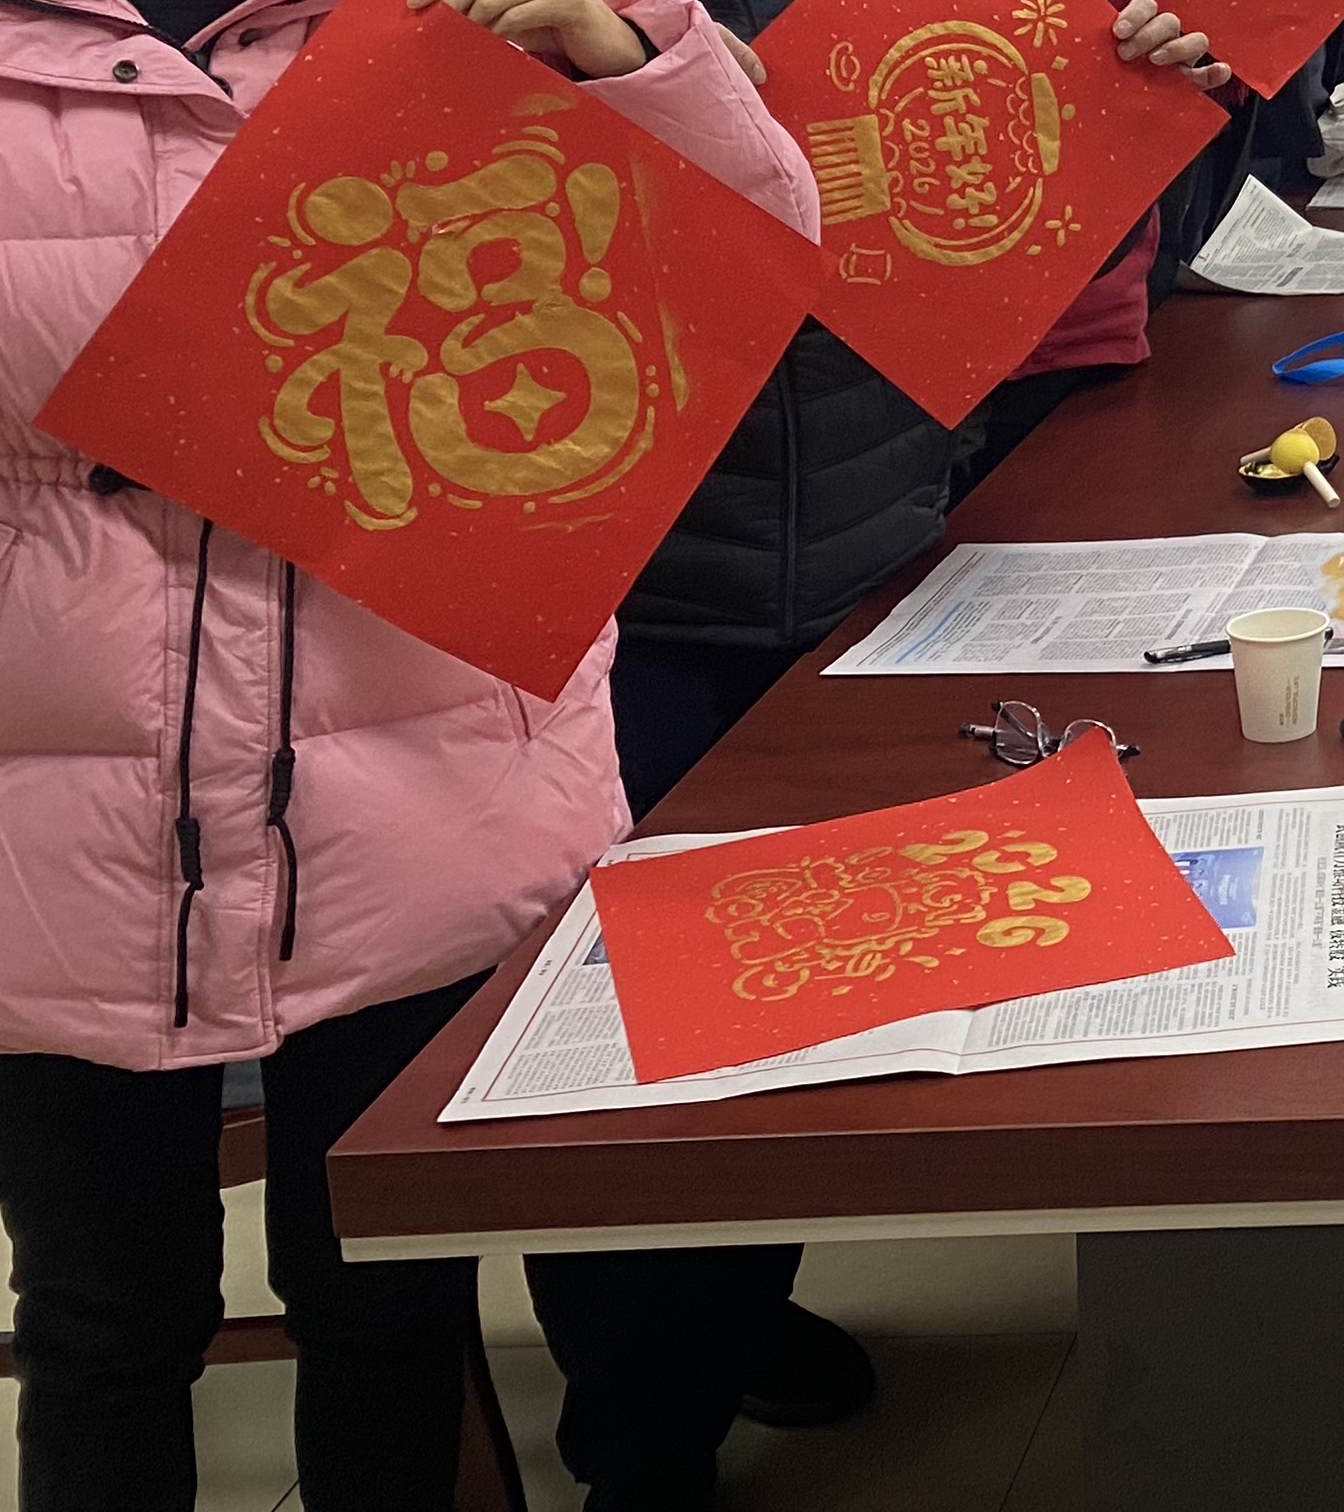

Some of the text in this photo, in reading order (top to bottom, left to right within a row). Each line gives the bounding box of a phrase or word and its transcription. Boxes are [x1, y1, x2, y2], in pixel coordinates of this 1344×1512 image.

[902, 118, 940, 194] 2026
[266, 154, 641, 518] 福
[898, 829, 1093, 949] 2026
